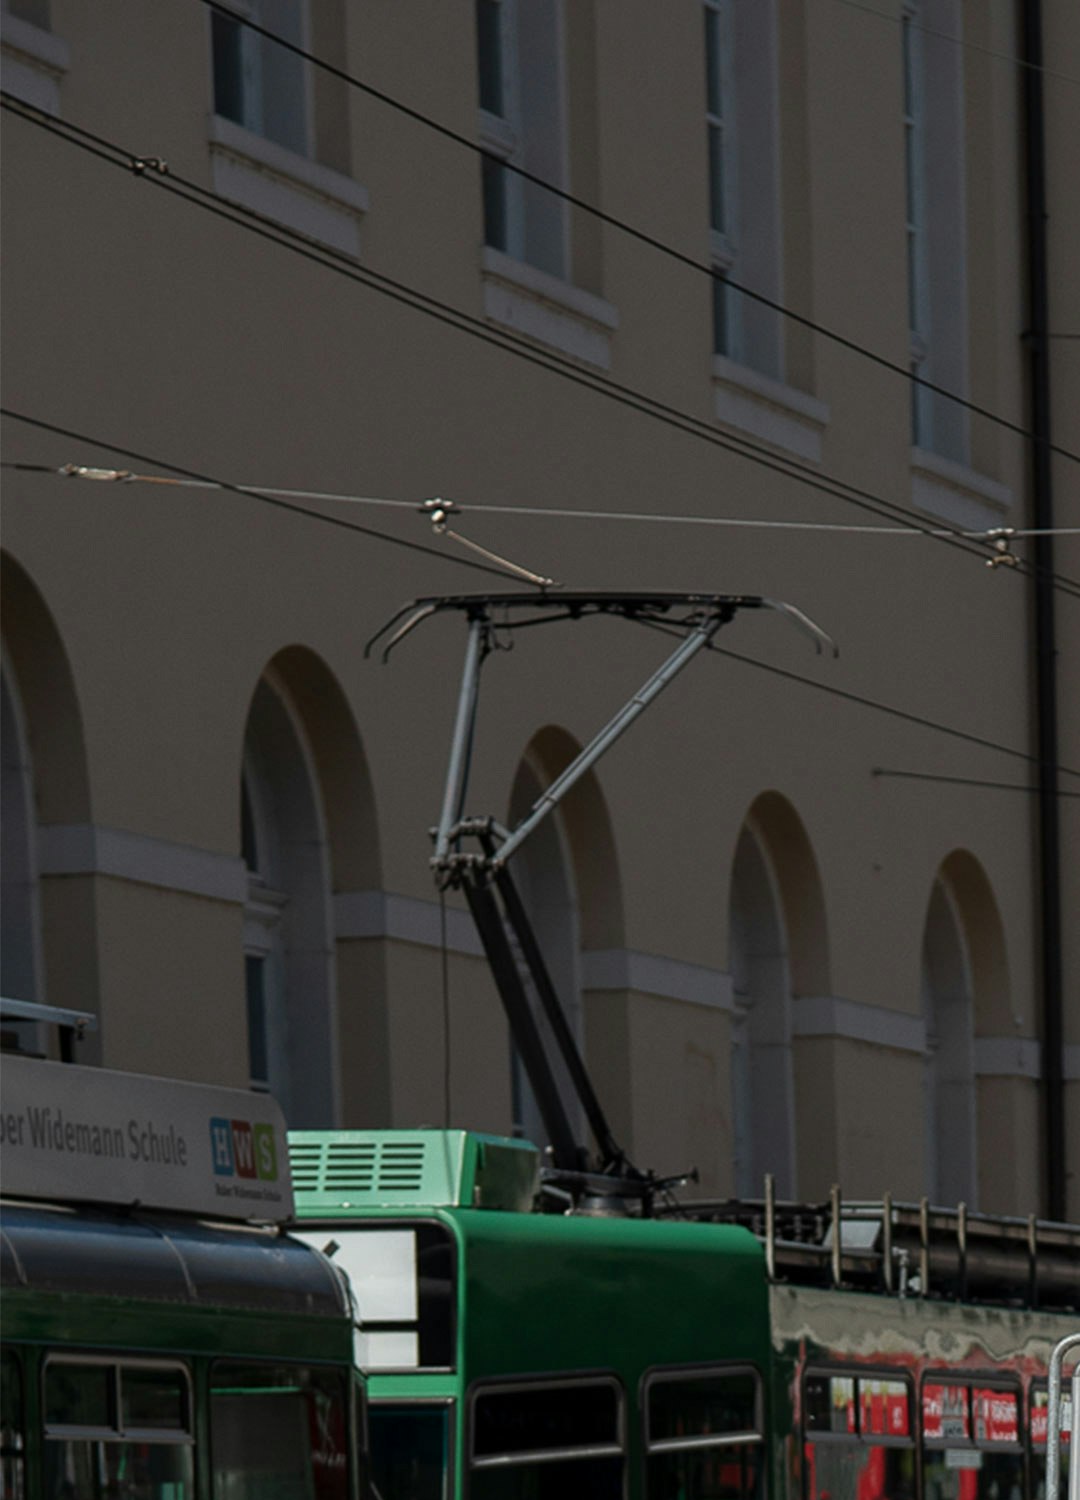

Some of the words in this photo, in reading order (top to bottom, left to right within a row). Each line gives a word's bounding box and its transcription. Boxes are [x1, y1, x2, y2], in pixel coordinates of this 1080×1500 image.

[27, 1105, 126, 1159] Widemann
[128, 1119, 188, 1166] Schule
[212, 1124, 275, 1175] HWS
